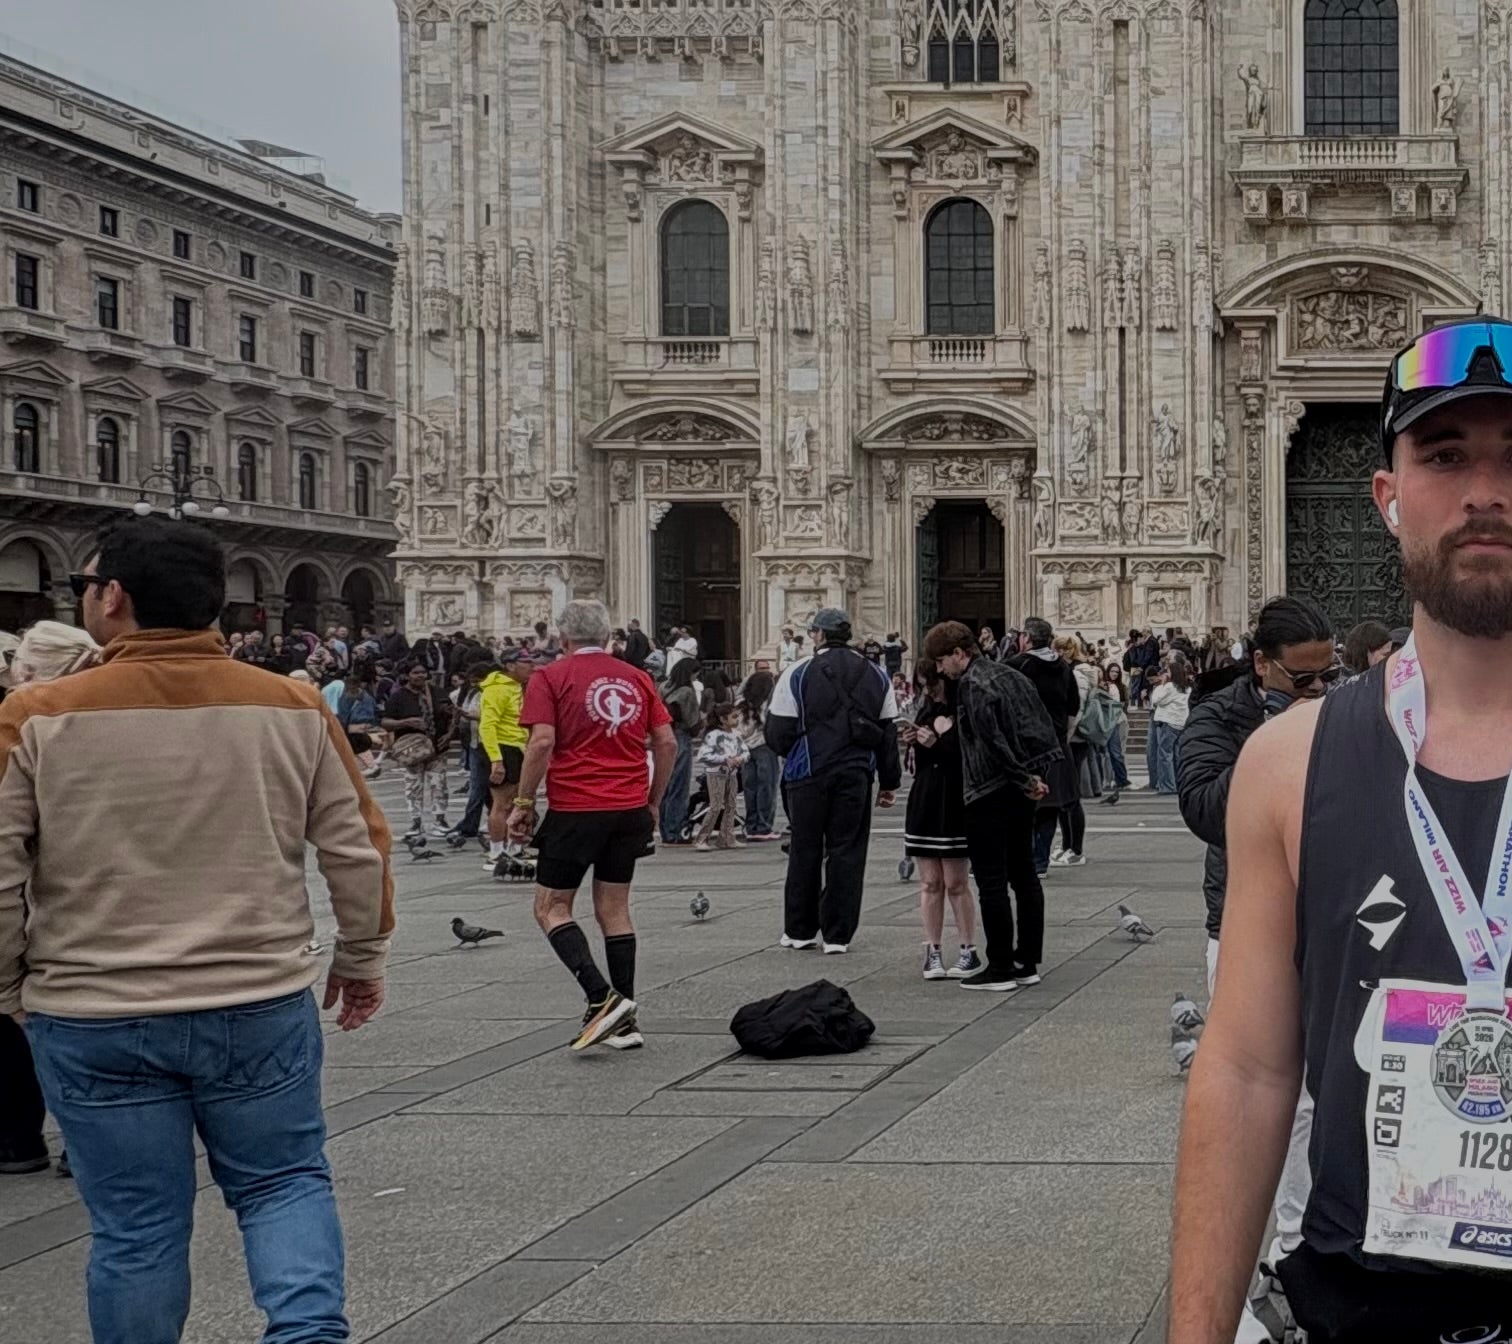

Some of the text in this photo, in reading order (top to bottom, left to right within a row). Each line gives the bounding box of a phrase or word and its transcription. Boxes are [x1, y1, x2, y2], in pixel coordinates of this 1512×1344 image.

[1408, 789, 1467, 915] WIZZ AIR MILANO
[1474, 1032, 1494, 1042] 2026
[1461, 1099, 1491, 1117] 42.195
[1476, 1230, 1512, 1247] asics
